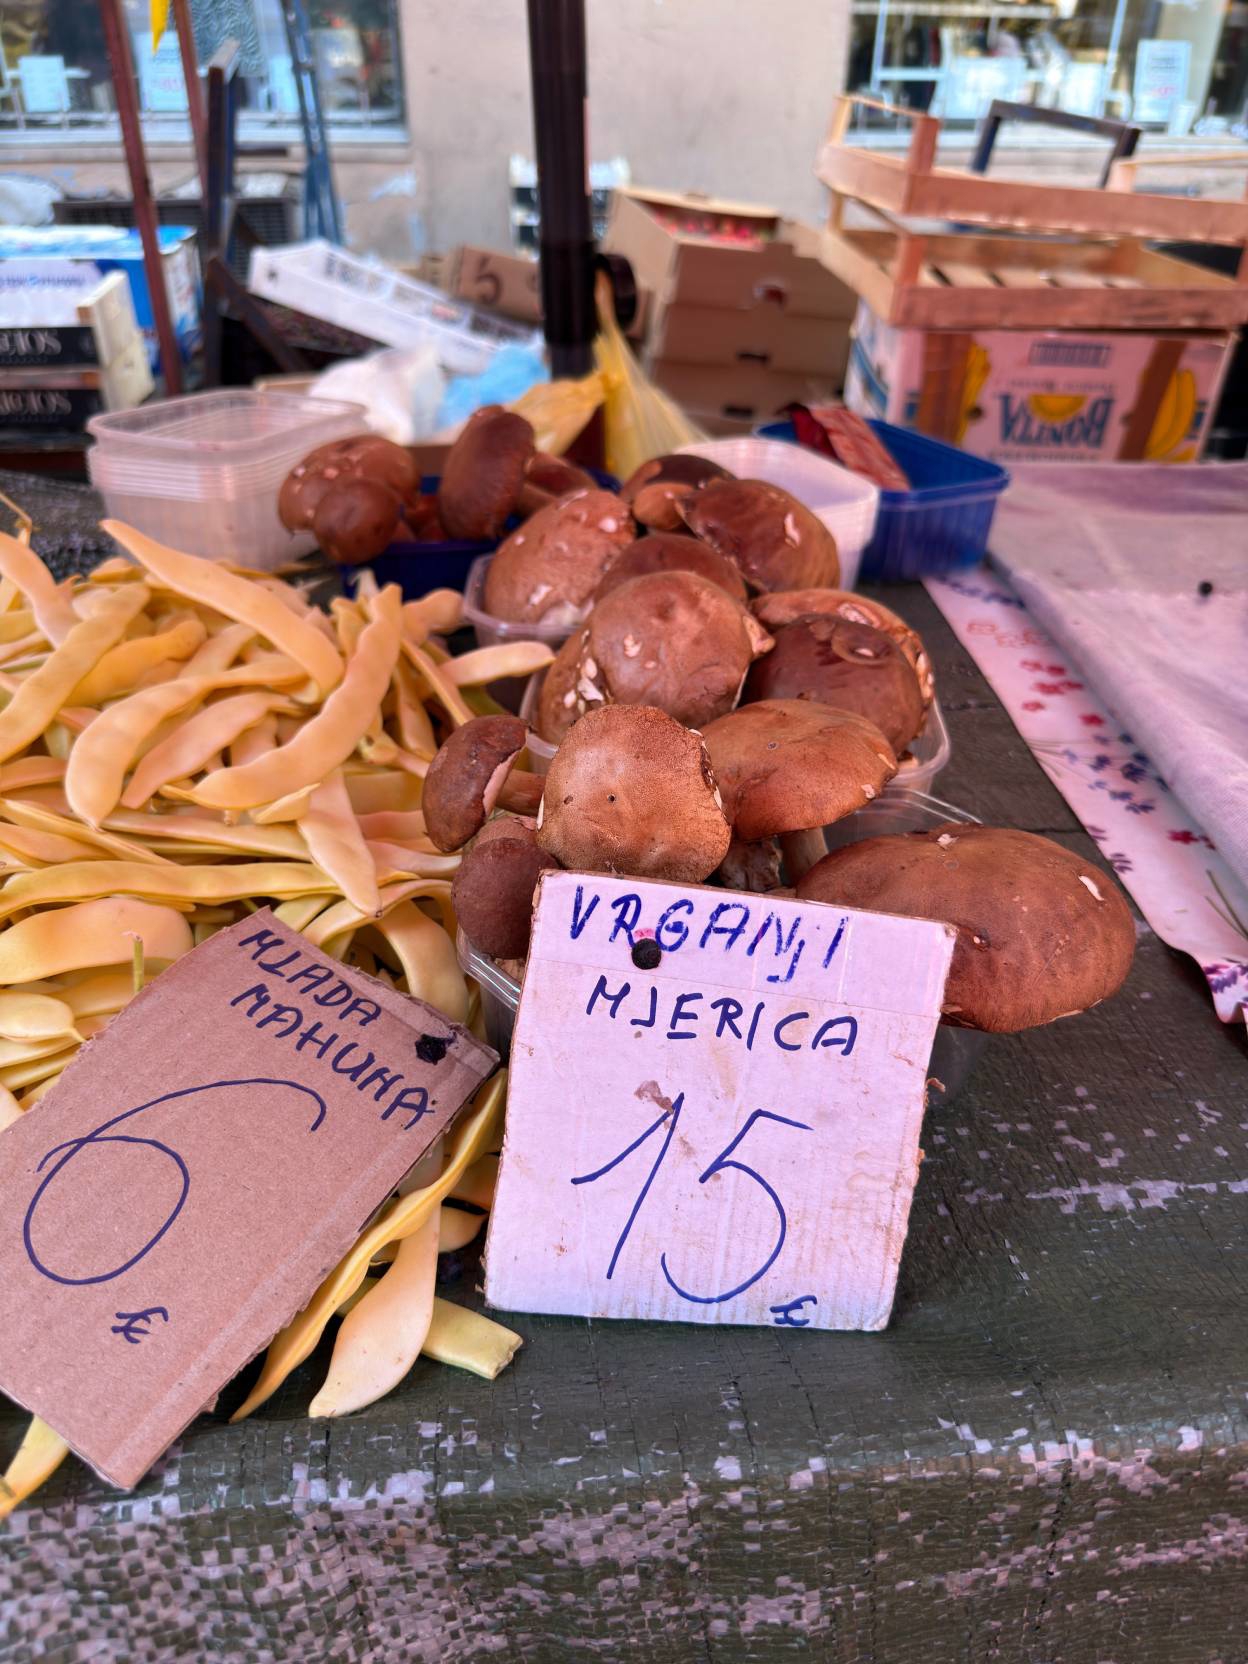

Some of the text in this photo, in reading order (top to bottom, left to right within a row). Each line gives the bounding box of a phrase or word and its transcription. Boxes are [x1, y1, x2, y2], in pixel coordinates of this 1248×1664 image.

[995, 391, 1115, 449] BONITA
[586, 974, 858, 1055] MJERICA
[23, 1077, 326, 1285] 6
[571, 1092, 814, 1303] 15
[111, 1306, 169, 1344] €
[769, 1295, 818, 1327] €
